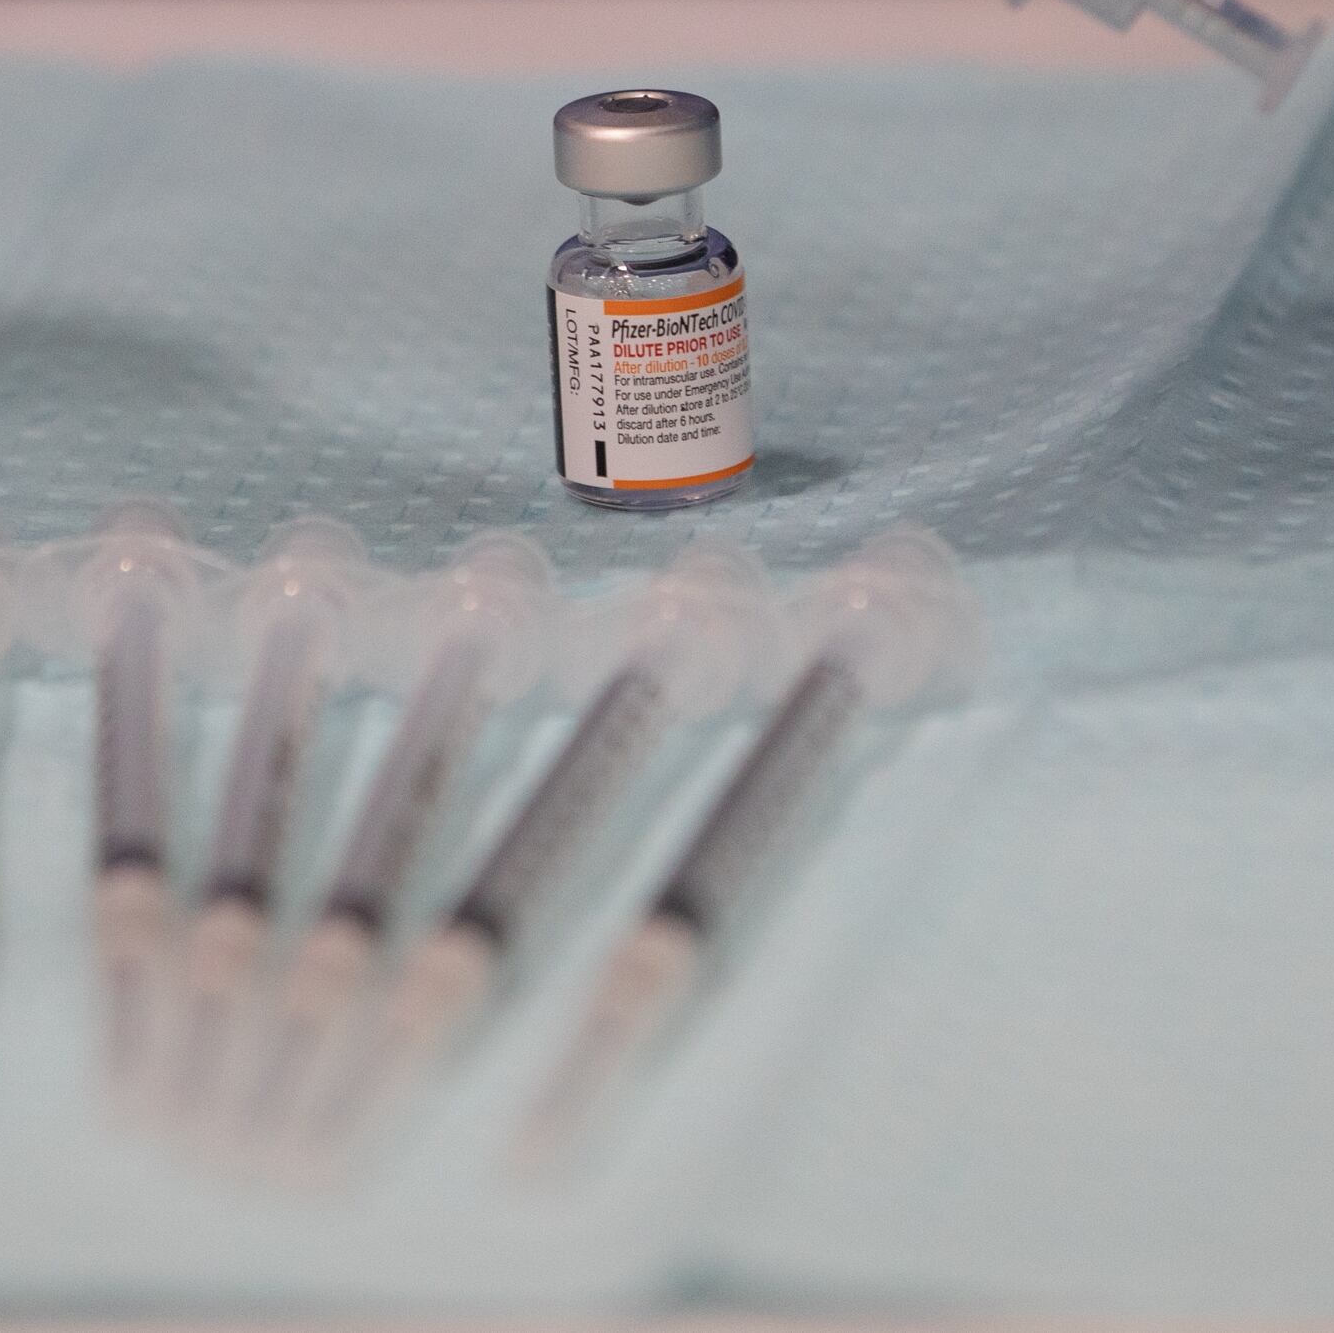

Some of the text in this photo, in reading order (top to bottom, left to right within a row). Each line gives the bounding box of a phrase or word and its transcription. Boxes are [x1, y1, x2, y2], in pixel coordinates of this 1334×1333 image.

[611, 308, 719, 343] Pfizer-BioNTech
[566, 308, 581, 396] LOT/MFG:
[613, 343, 663, 358] DILUTE
[667, 337, 708, 356] PRIOR
[710, 331, 724, 348] TO
[726, 324, 741, 343] USE
[614, 361, 641, 375] After
[645, 359, 687, 374] dilution
[697, 354, 709, 368] 10
[712, 346, 735, 364] doses
[588, 324, 606, 431] PAA177913
[615, 374, 630, 386] For
[633, 371, 698, 386] intramuscular
[700, 368, 716, 380] use.
[615, 389, 630, 401] For
[634, 391, 651, 401] use
[655, 388, 683, 400] under
[685, 378, 729, 397] Emergency
[616, 404, 639, 415] After
[642, 403, 678, 415] dilution
[680, 400, 703, 412] store
[705, 398, 714, 408] at
[715, 395, 720, 405] 2
[722, 393, 728, 403] to
[617, 412, 715, 430] discard after 6 hours.
[618, 425, 721, 445] Dilution date and time:
